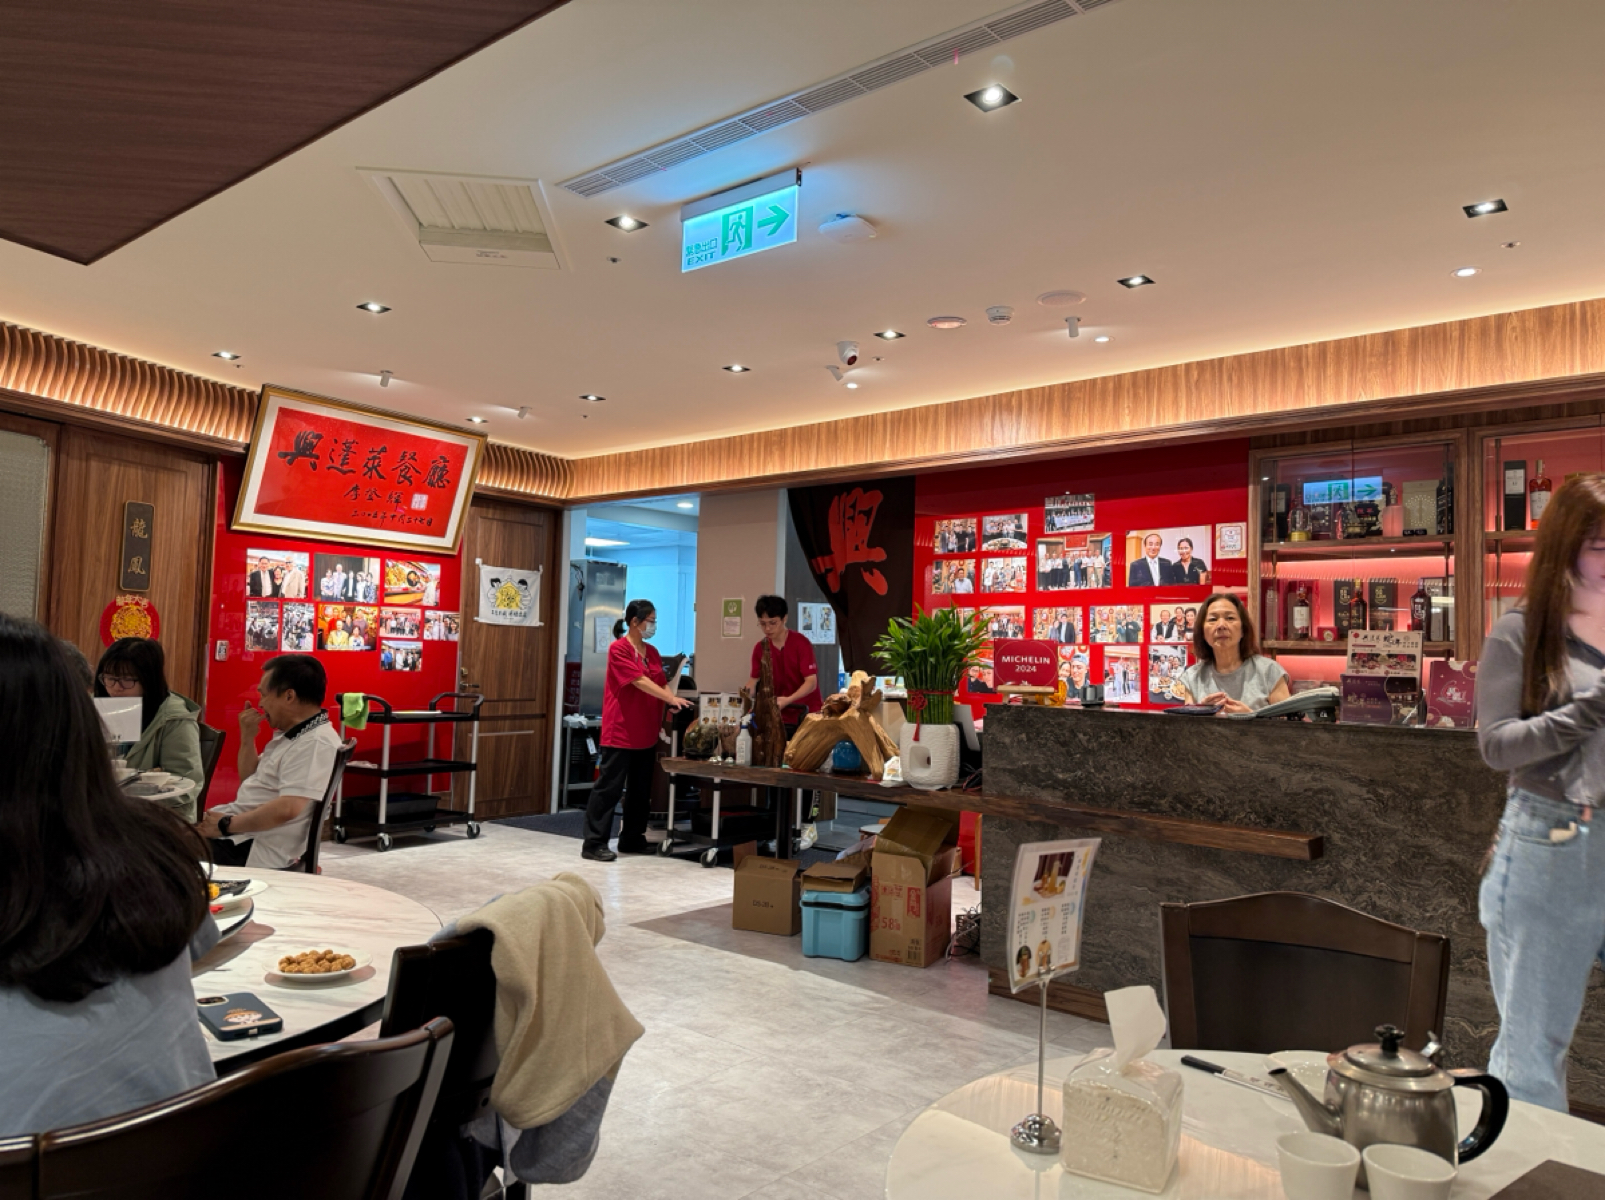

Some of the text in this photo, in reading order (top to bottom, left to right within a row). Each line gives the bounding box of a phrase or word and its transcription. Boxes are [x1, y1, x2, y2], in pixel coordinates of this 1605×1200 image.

[685, 237, 718, 257] 緊急出口
[686, 251, 716, 265] EXIT
[277, 430, 451, 488] 興蓬萊餐廳
[127, 518, 148, 575] 龍鳳
[1001, 655, 1051, 665] MICHELIN
[1014, 664, 1037, 673] 2024
